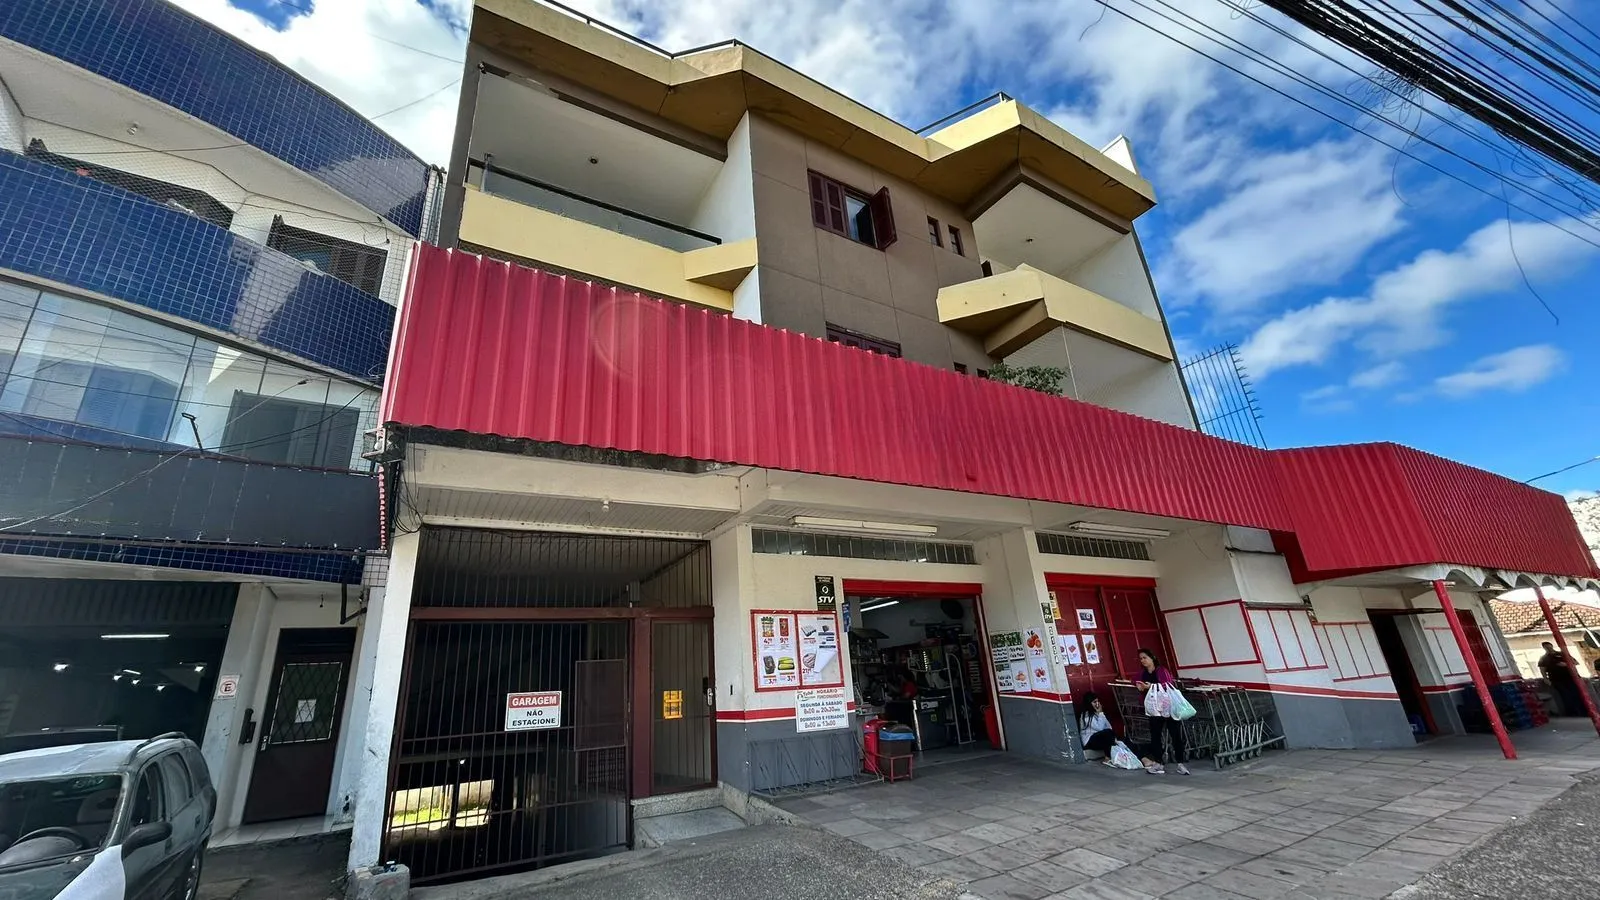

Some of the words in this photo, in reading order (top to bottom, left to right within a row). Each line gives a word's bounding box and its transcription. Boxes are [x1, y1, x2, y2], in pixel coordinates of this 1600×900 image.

[224, 683, 232, 692] E
[512, 696, 557, 706] GARAGEM
[526, 708, 543, 717] NÃO
[512, 718, 556, 726] ESTACIONE
